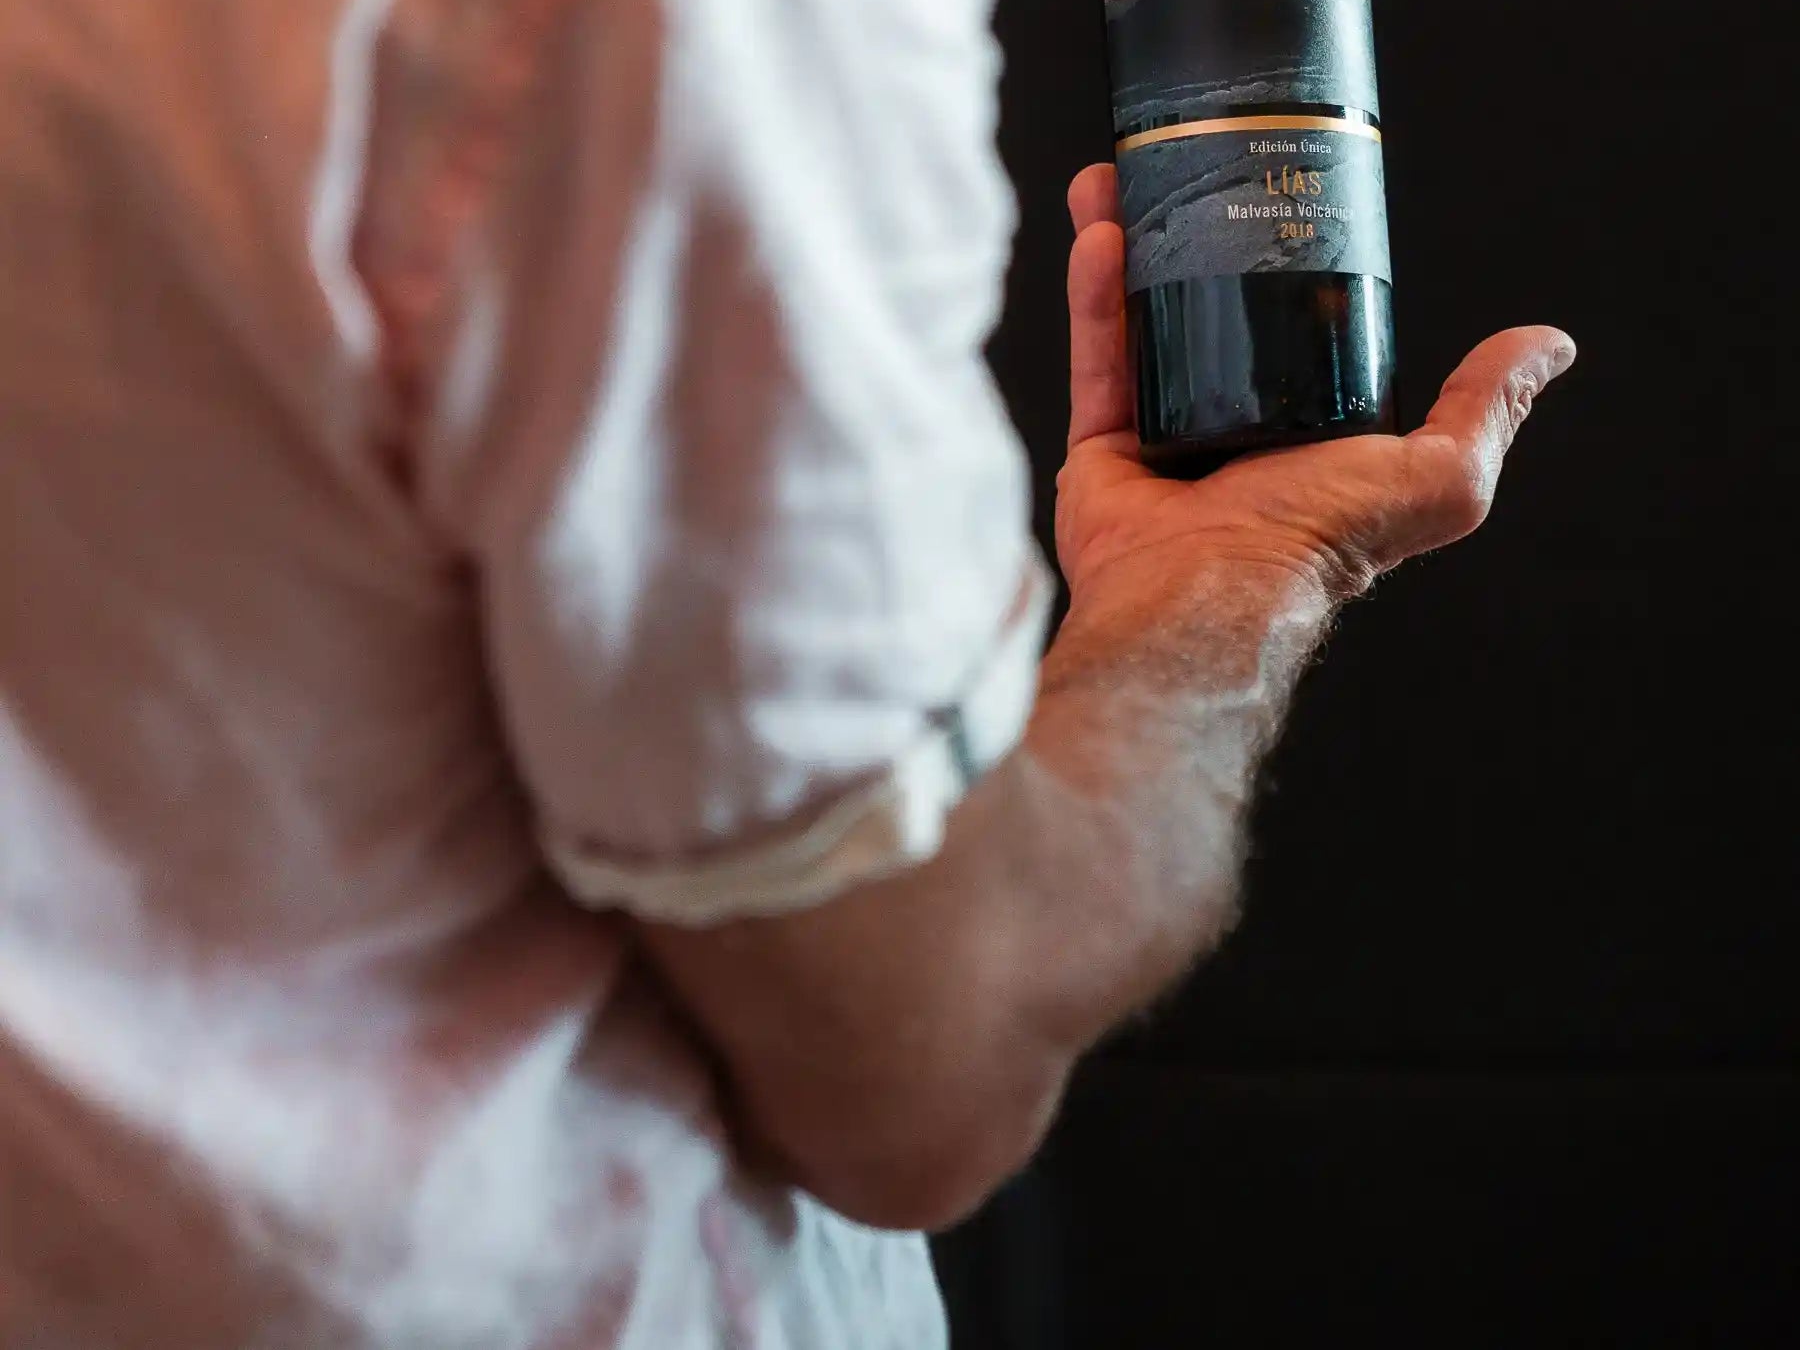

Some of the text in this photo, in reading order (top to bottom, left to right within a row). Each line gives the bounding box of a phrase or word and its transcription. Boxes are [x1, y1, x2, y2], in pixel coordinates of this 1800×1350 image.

[1249, 138, 1332, 154] Edición Única
[1265, 164, 1323, 196] LÍAS
[1227, 202, 1292, 220] Malvasía
[1280, 221, 1315, 238] 2018
